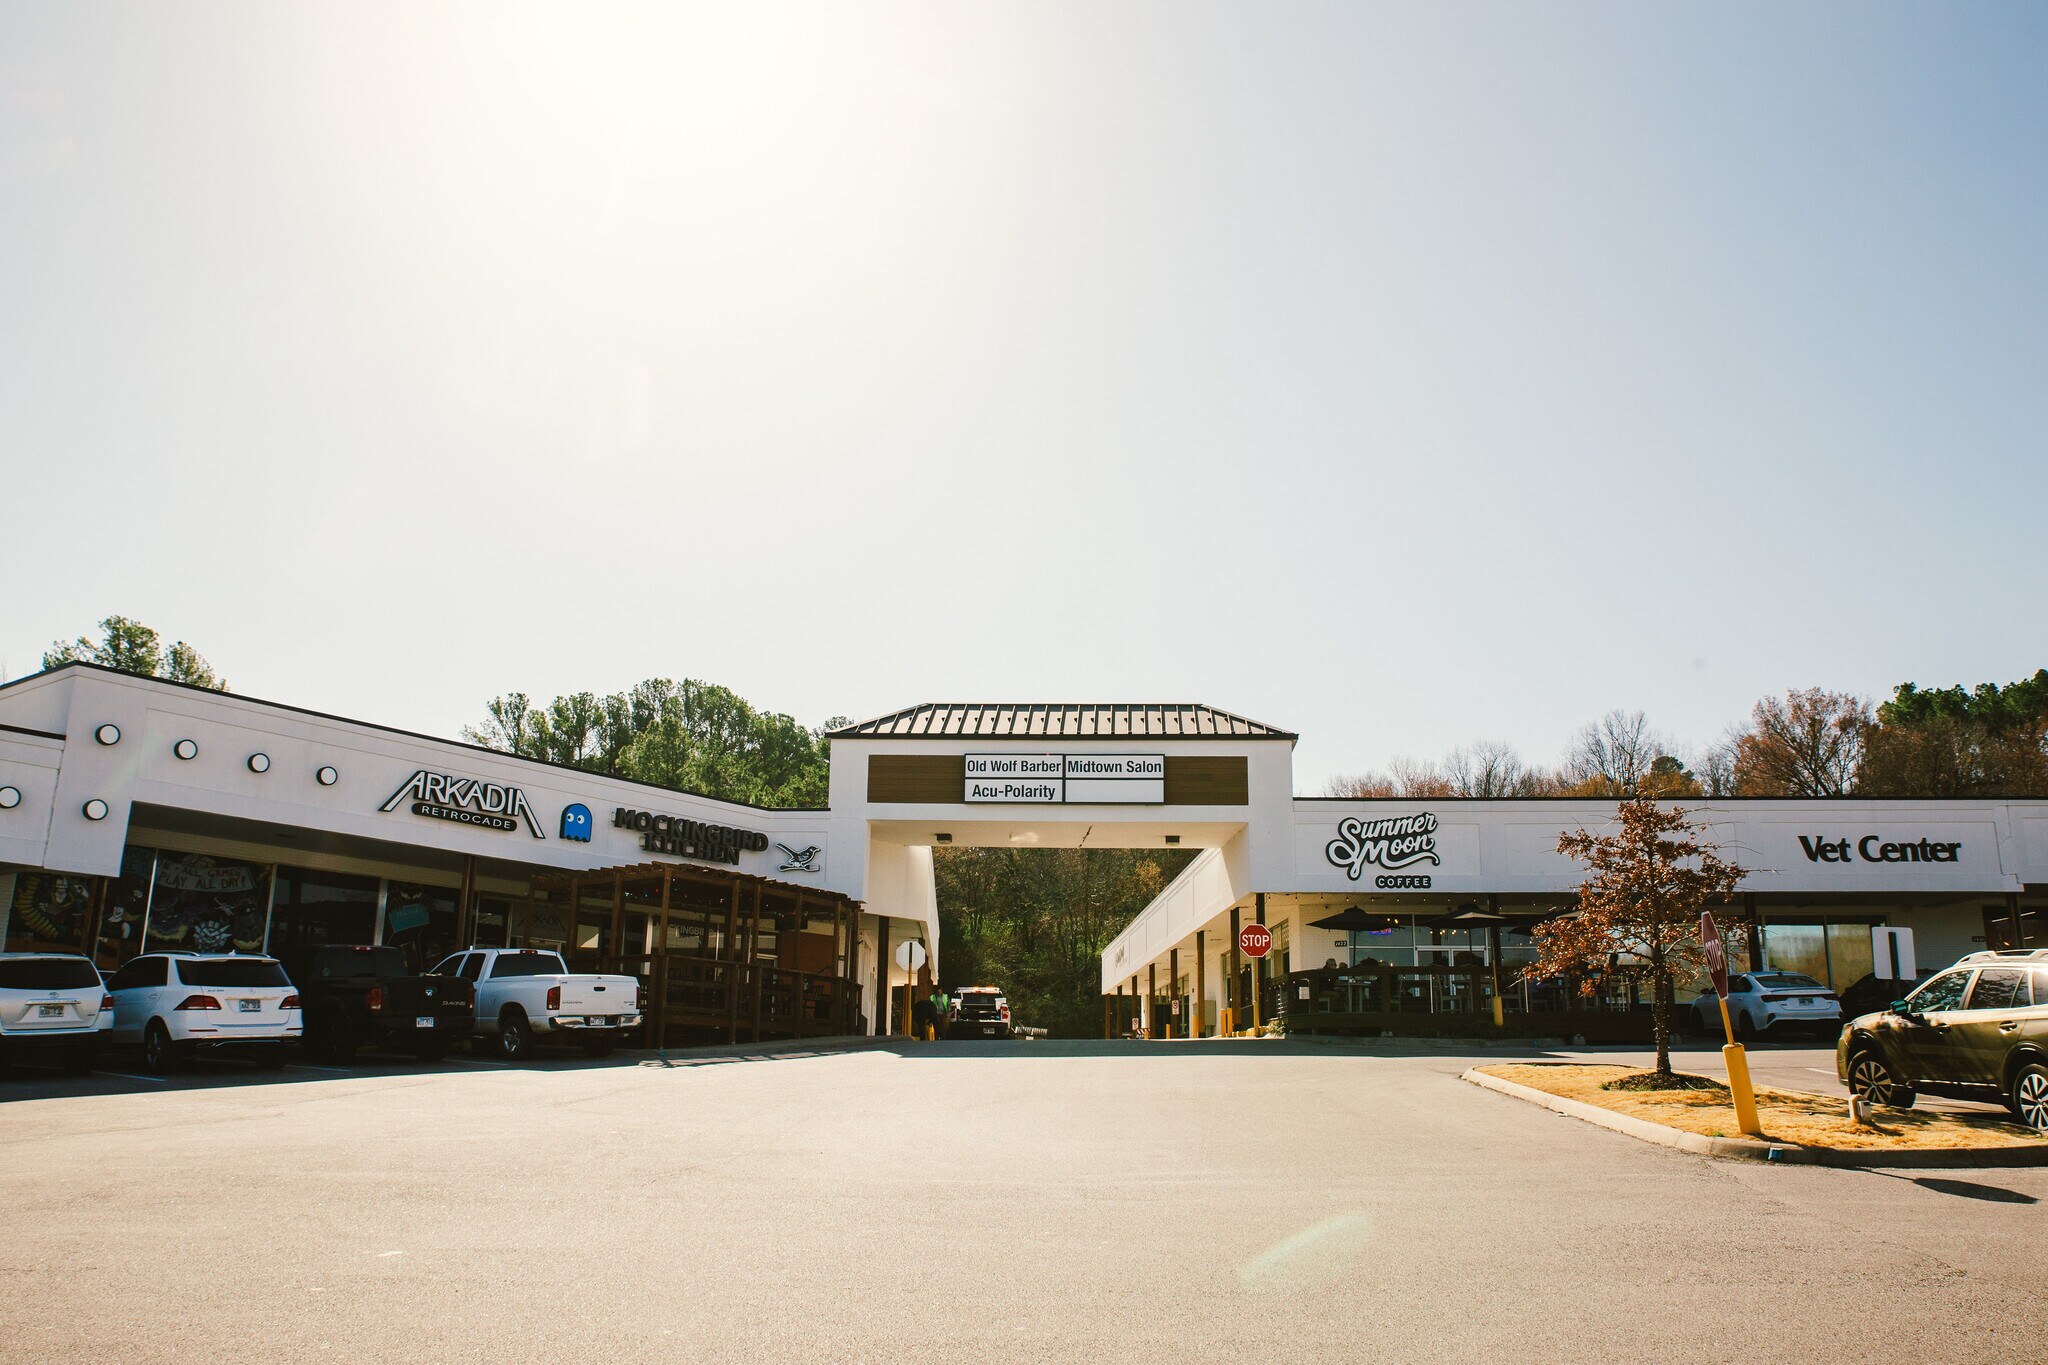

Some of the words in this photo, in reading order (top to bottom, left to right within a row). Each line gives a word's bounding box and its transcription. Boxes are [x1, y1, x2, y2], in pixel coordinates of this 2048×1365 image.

[967, 760, 987, 772] Old
[990, 760, 1018, 772] Wolf
[1021, 760, 1062, 772] Barber
[1067, 760, 1122, 773] Midtown
[1126, 760, 1162, 773] Salon
[972, 784, 1056, 801] Acu-Polarity
[379, 770, 546, 839] ARKADIA
[421, 805, 511, 829] RETROCADE
[613, 807, 769, 852] MOCKINGBIRD
[642, 832, 741, 866] KITCHEN
[1363, 834, 1438, 868] Moon
[1797, 835, 1852, 863] Vet
[1858, 835, 1962, 863] Center
[160, 871, 187, 888] PLAY
[195, 878, 216, 889] ALL
[208, 868, 241, 878] GAMES
[1378, 877, 1429, 887] COFFEE
[1241, 934, 1270, 947] STOP
[1705, 938, 1723, 973] STOP
